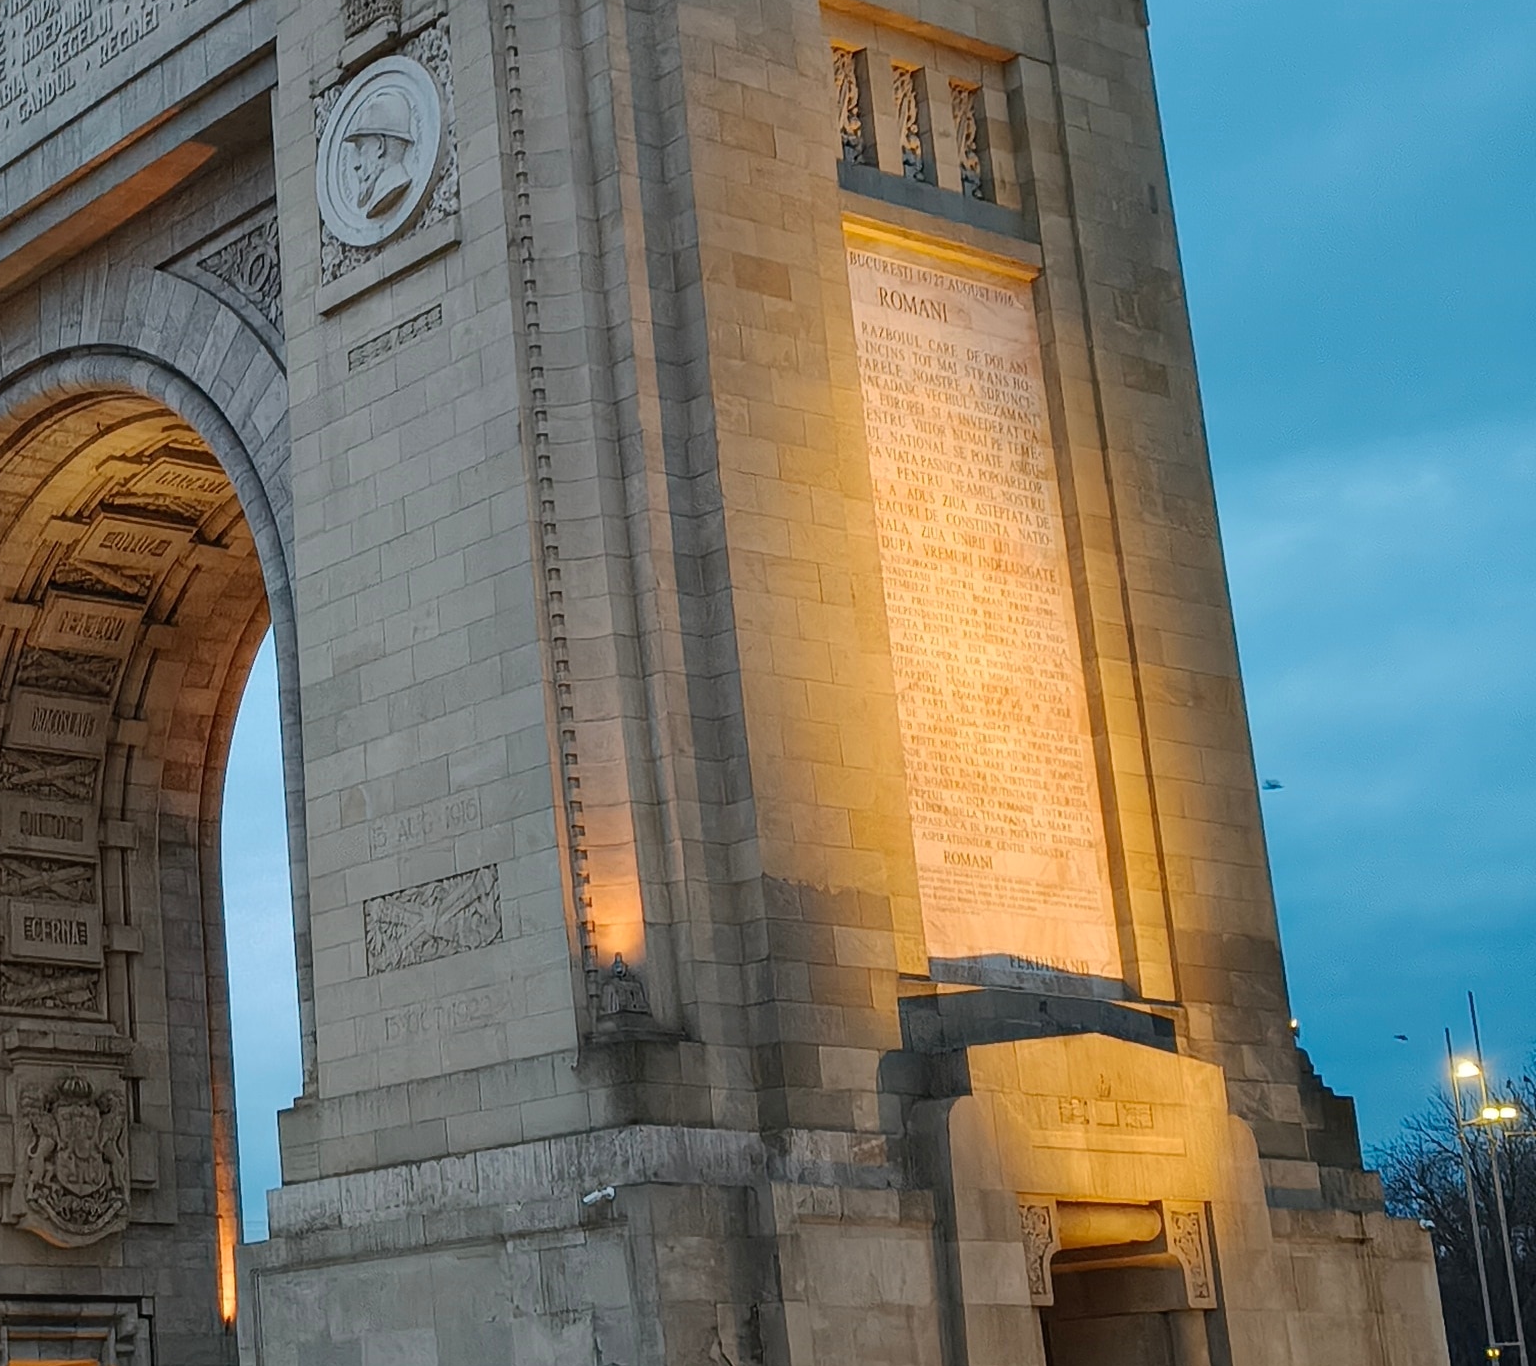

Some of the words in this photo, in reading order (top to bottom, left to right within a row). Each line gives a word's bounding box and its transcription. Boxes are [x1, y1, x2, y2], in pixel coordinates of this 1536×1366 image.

[877, 282, 949, 325] ROMANI
[864, 404, 906, 430] ENTRU
[942, 849, 994, 870] ROMANI
[31, 918, 81, 946] CERNA
[1008, 952, 1090, 976] FERDINAND
